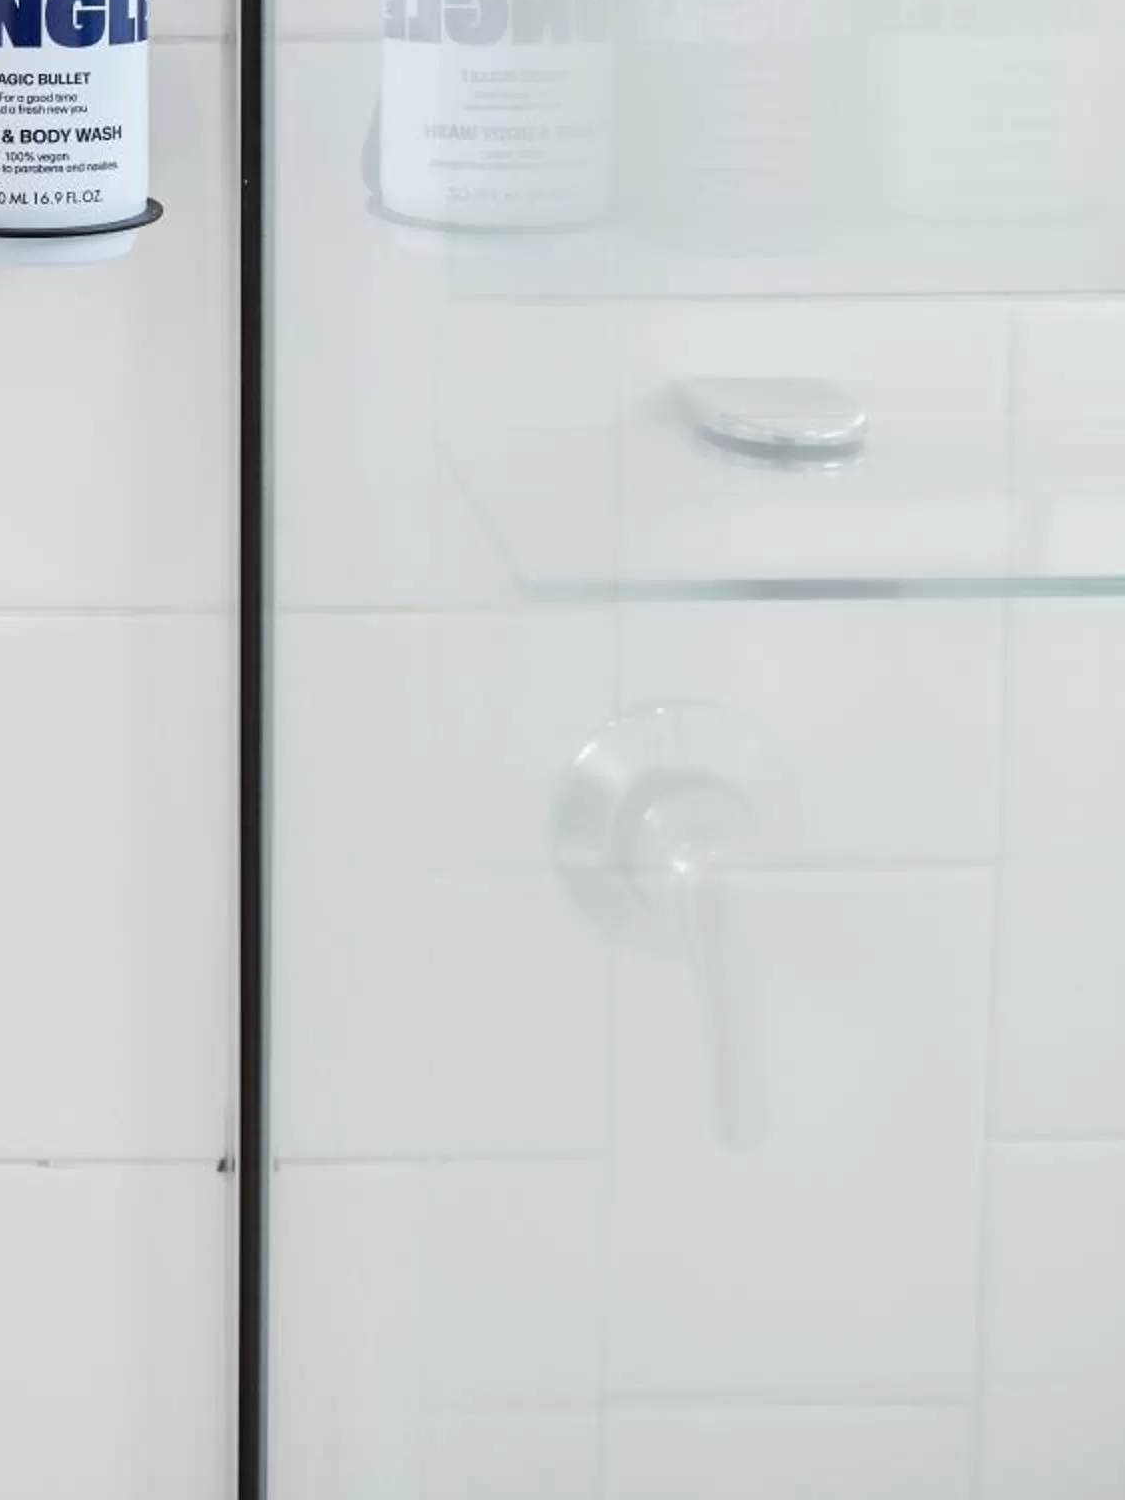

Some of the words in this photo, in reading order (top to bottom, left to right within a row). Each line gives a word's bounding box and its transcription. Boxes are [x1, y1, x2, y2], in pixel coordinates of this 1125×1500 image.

[38, 72, 91, 85] BULLET
[17, 94, 24, 102] a
[27, 93, 53, 104] good
[18, 105, 45, 115] fresh
[70, 106, 88, 116] you
[1, 129, 14, 144] &
[20, 129, 72, 144] BODY
[76, 125, 122, 143] WASH
[5, 151, 35, 162] 100%
[9, 191, 29, 205] ML
[34, 191, 63, 205] 16.9
